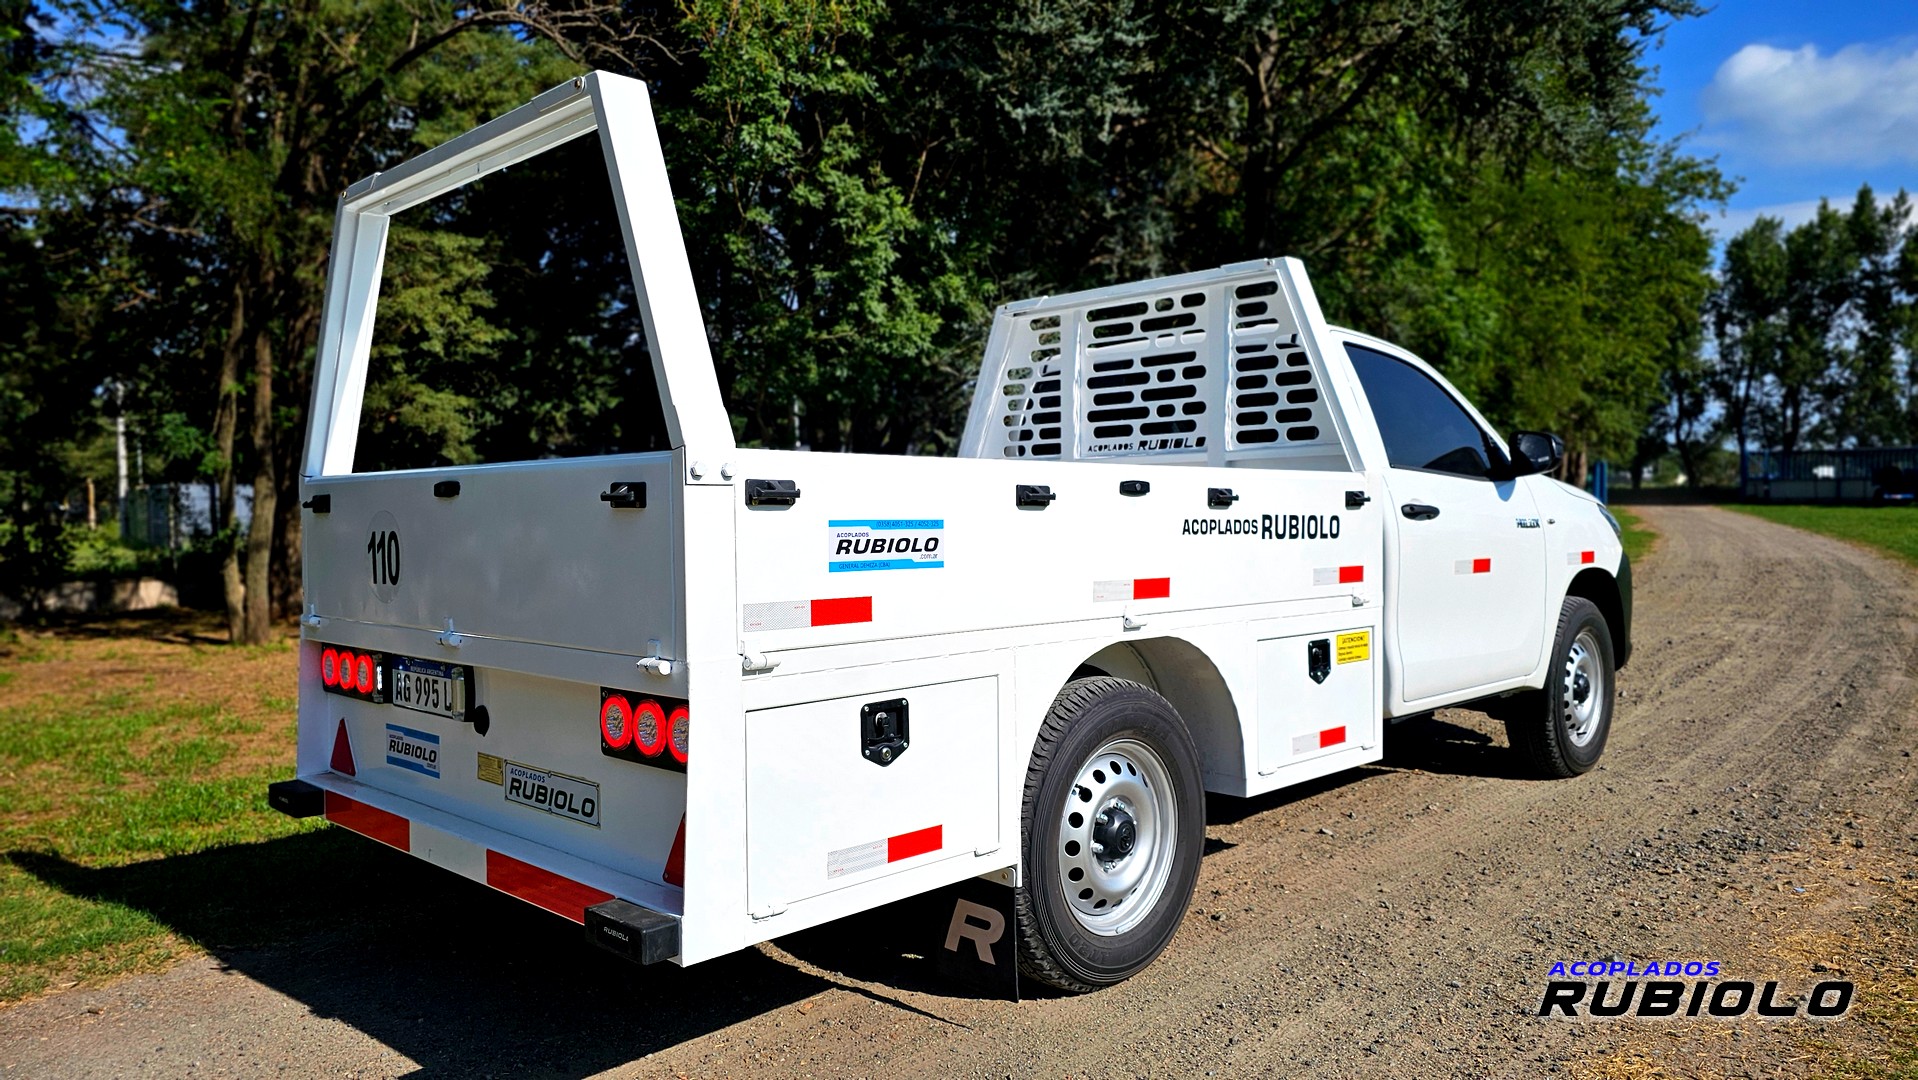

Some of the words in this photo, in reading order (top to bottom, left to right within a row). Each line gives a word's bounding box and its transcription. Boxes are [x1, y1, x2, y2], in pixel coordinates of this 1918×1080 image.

[1088, 443, 1134, 452] ACOPLADOS
[1137, 436, 1206, 451] RUBIOLO
[1182, 519, 1258, 535] ACOPLADOS
[1261, 514, 1340, 540] RUBIOLO
[367, 530, 400, 586] 110
[835, 537, 940, 555] RUBIOLO
[839, 562, 860, 570] GENERAL
[396, 672, 411, 703] AG
[415, 676, 440, 709] 995
[388, 739, 437, 763] RUBIOLO
[510, 767, 546, 783] ACOPLADOS
[508, 777, 596, 818] RUBIOLO
[944, 898, 1006, 966] R
